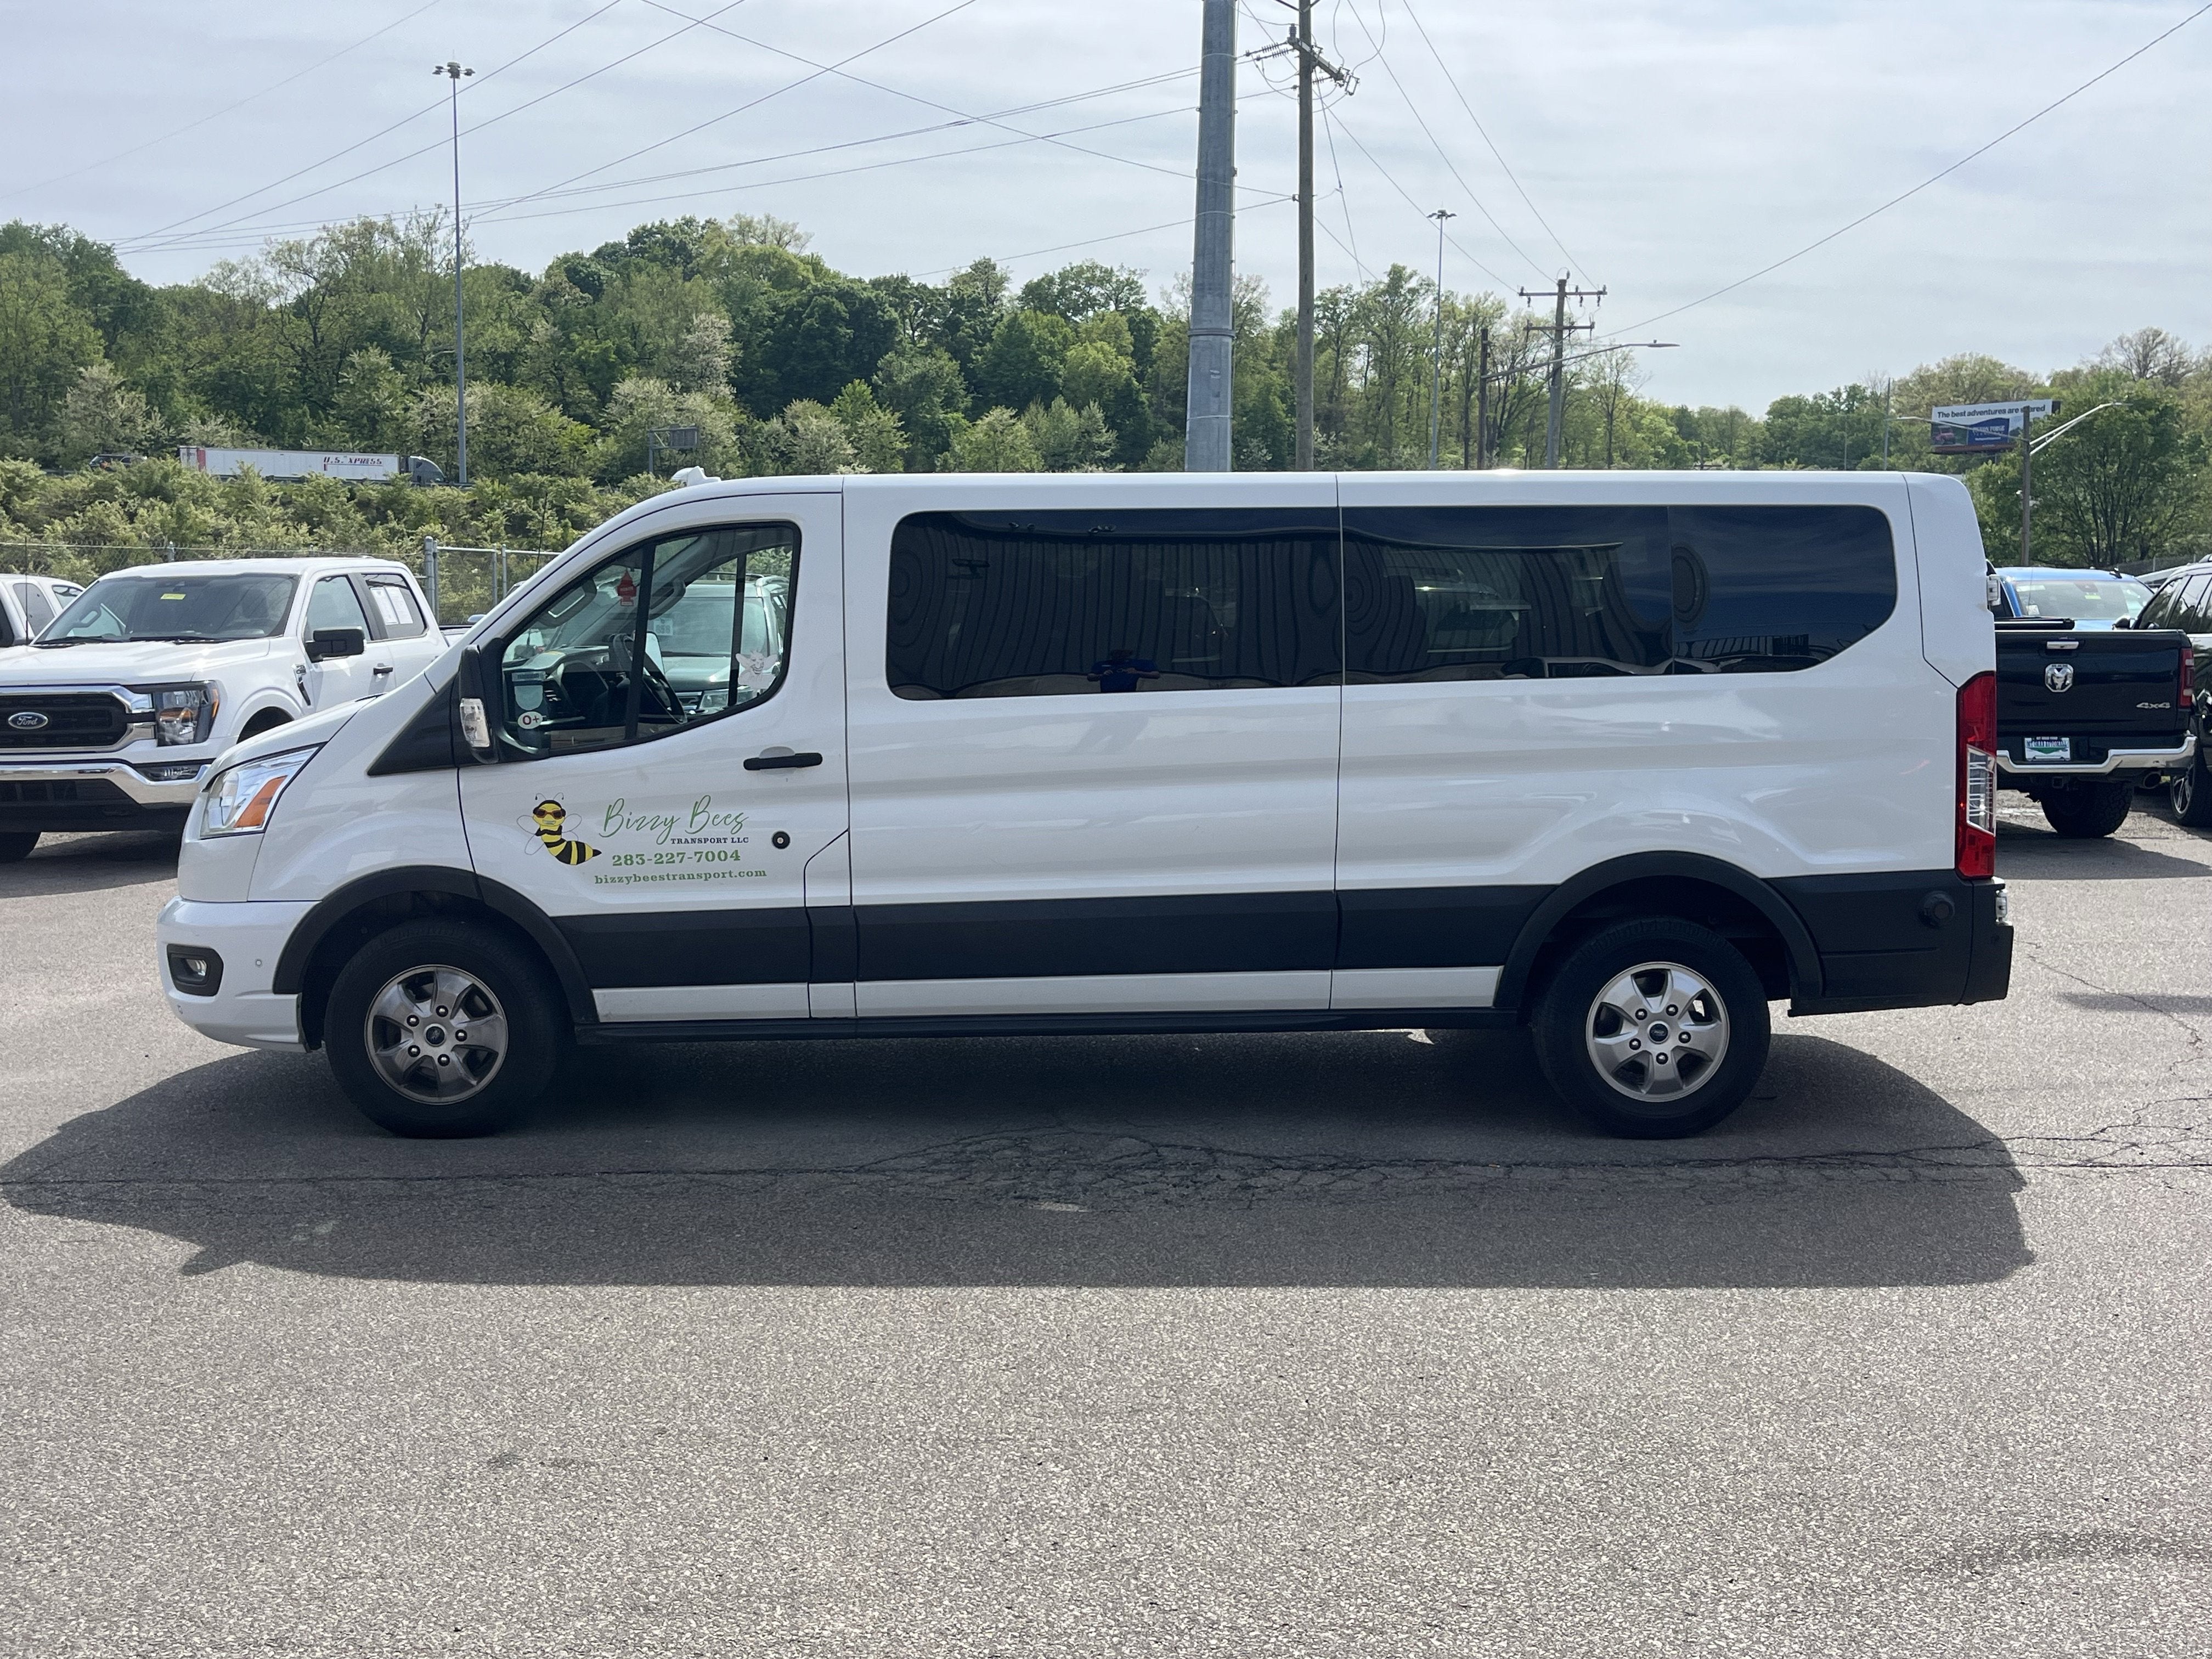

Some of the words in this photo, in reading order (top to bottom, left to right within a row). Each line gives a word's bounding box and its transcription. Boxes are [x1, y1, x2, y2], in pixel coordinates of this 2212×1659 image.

[1967, 408, 2006, 416] adventures
[16, 715, 38, 726] Ford
[599, 798, 681, 845] Bizzy
[685, 794, 749, 835] Bees
[594, 868, 768, 885] bizzybeestransport.com
